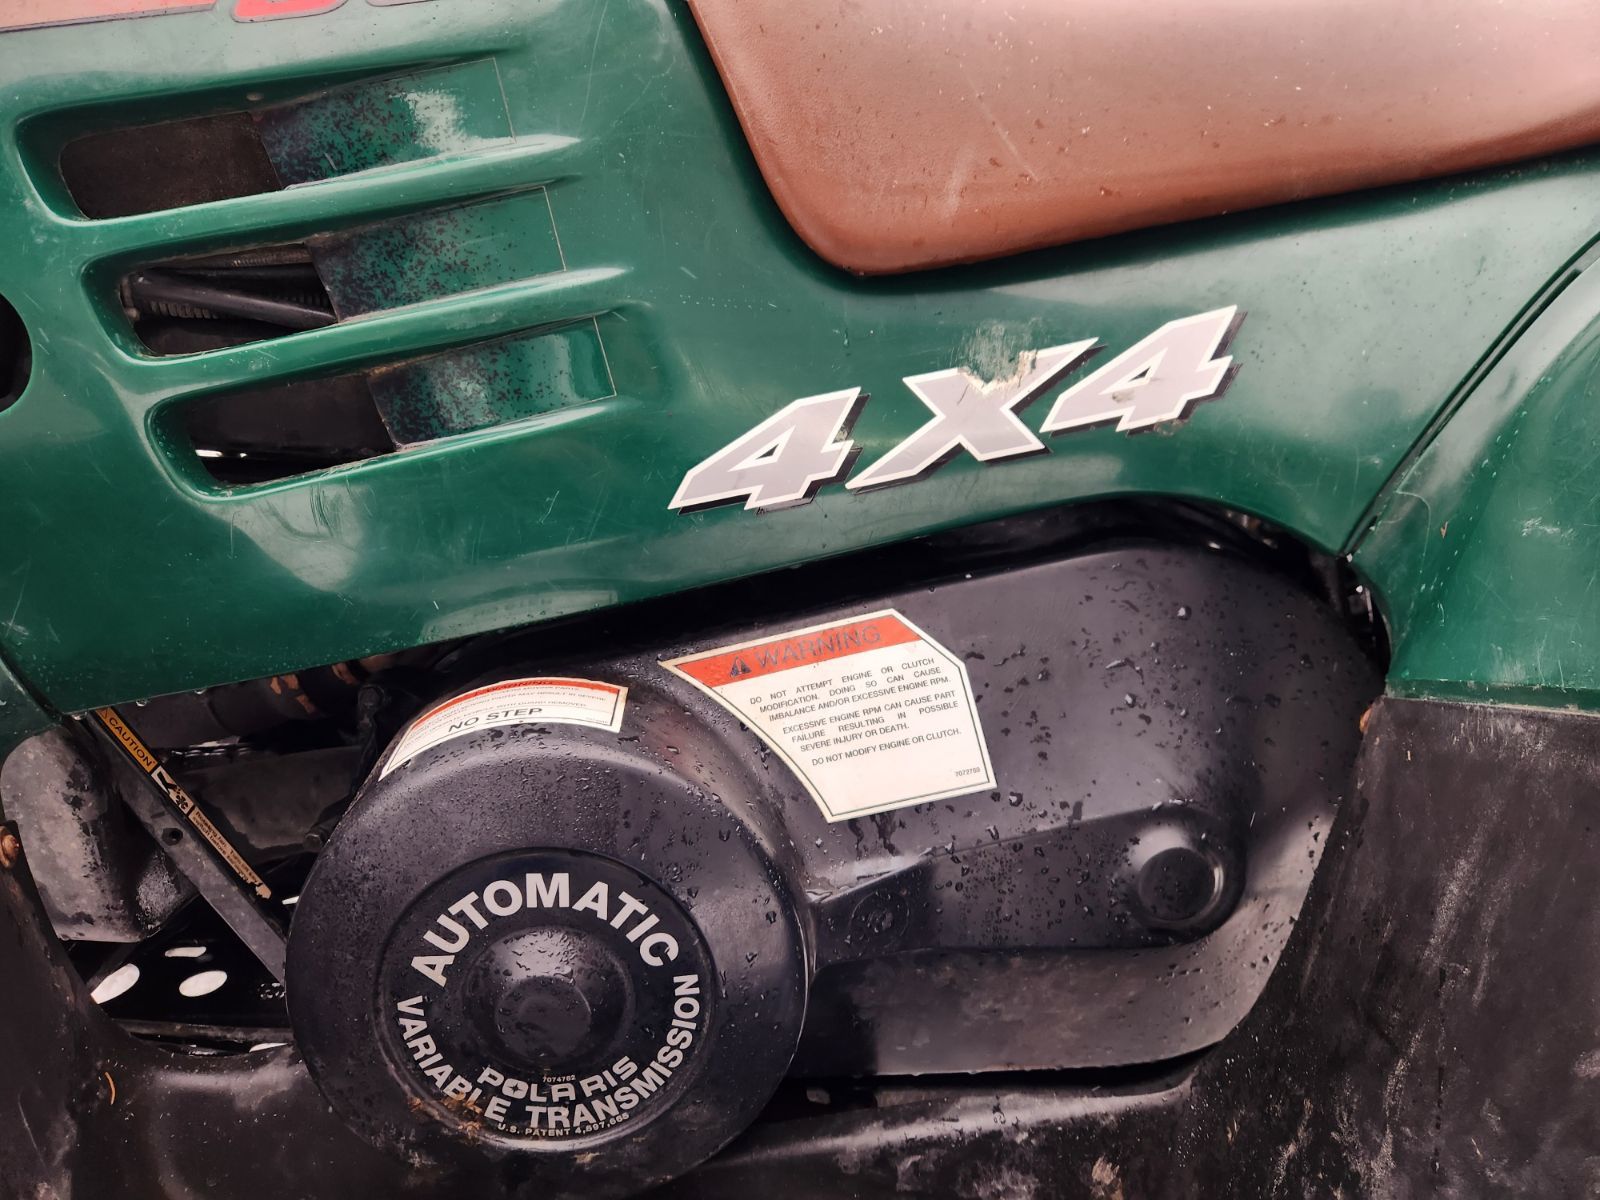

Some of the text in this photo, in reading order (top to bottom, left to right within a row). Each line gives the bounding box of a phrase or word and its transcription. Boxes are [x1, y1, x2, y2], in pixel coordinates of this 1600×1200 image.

[667, 304, 1244, 514] 4X4
[754, 625, 881, 669] WARNING
[750, 658, 934, 705] DO NOT ATTEMPT ENGINE OR CLUTCH
[769, 676, 950, 722] IMBALANCE AND/OR EXCESSIVE ENGINE RPM.
[829, 684, 856, 697] DOING
[865, 680, 877, 688] SO
[886, 674, 904, 684] CAN
[914, 666, 941, 678] CAUSE
[448, 707, 543, 732] NO STEP
[783, 690, 956, 735] EXCESSIVE ENGINE RPM CAN CAUSE PART
[792, 700, 958, 743] FAILURE RESULTING IN POSSIBLE
[109, 716, 153, 767] CAUTION
[800, 722, 910, 752] SEVERE INJURY OR DEATH.
[812, 728, 962, 766] DO NOT MODIFY ENGINE OR CLUTCH.
[410, 872, 679, 988] AUTOMATIC
[397, 974, 700, 1129] VARIABLE TRANSMISSION
[476, 1055, 638, 1102] POLARIS
[524, 1127, 571, 1137] PATENT
